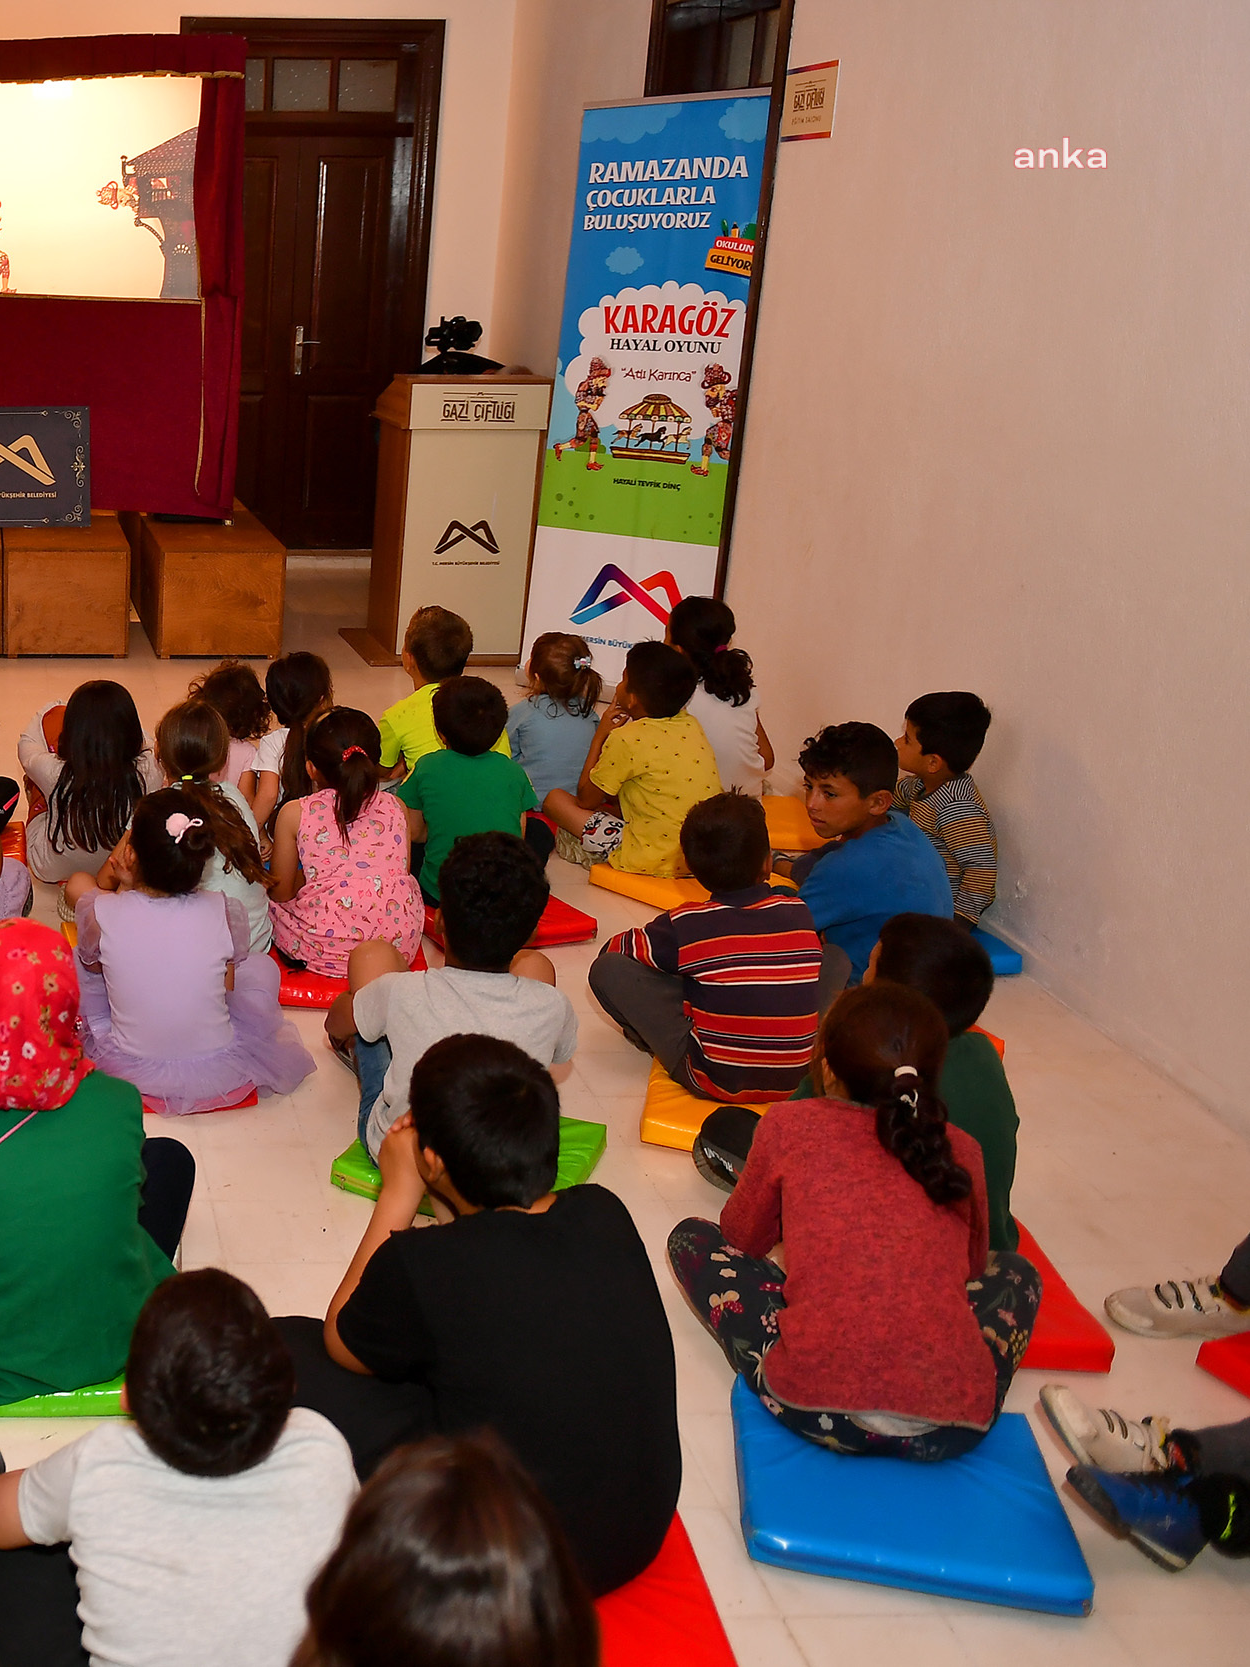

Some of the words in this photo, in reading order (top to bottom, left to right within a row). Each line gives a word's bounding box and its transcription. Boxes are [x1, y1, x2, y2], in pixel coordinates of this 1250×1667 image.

[588, 155, 749, 184] RAMAZANDA
[586, 185, 717, 212] ÇOCUKLARLA
[583, 211, 712, 233] BULUŞUYORUZ
[603, 300, 737, 339] KARAGÖZ
[609, 338, 661, 352] HAYAL
[664, 340, 722, 354] OYUNU
[441, 400, 470, 422] GAZİ
[472, 400, 516, 423] ÇİFTLİĞİ
[612, 477, 637, 486] HAYALİ
[638, 480, 661, 489] TEVFİK
[662, 482, 682, 491] DİNÇ
